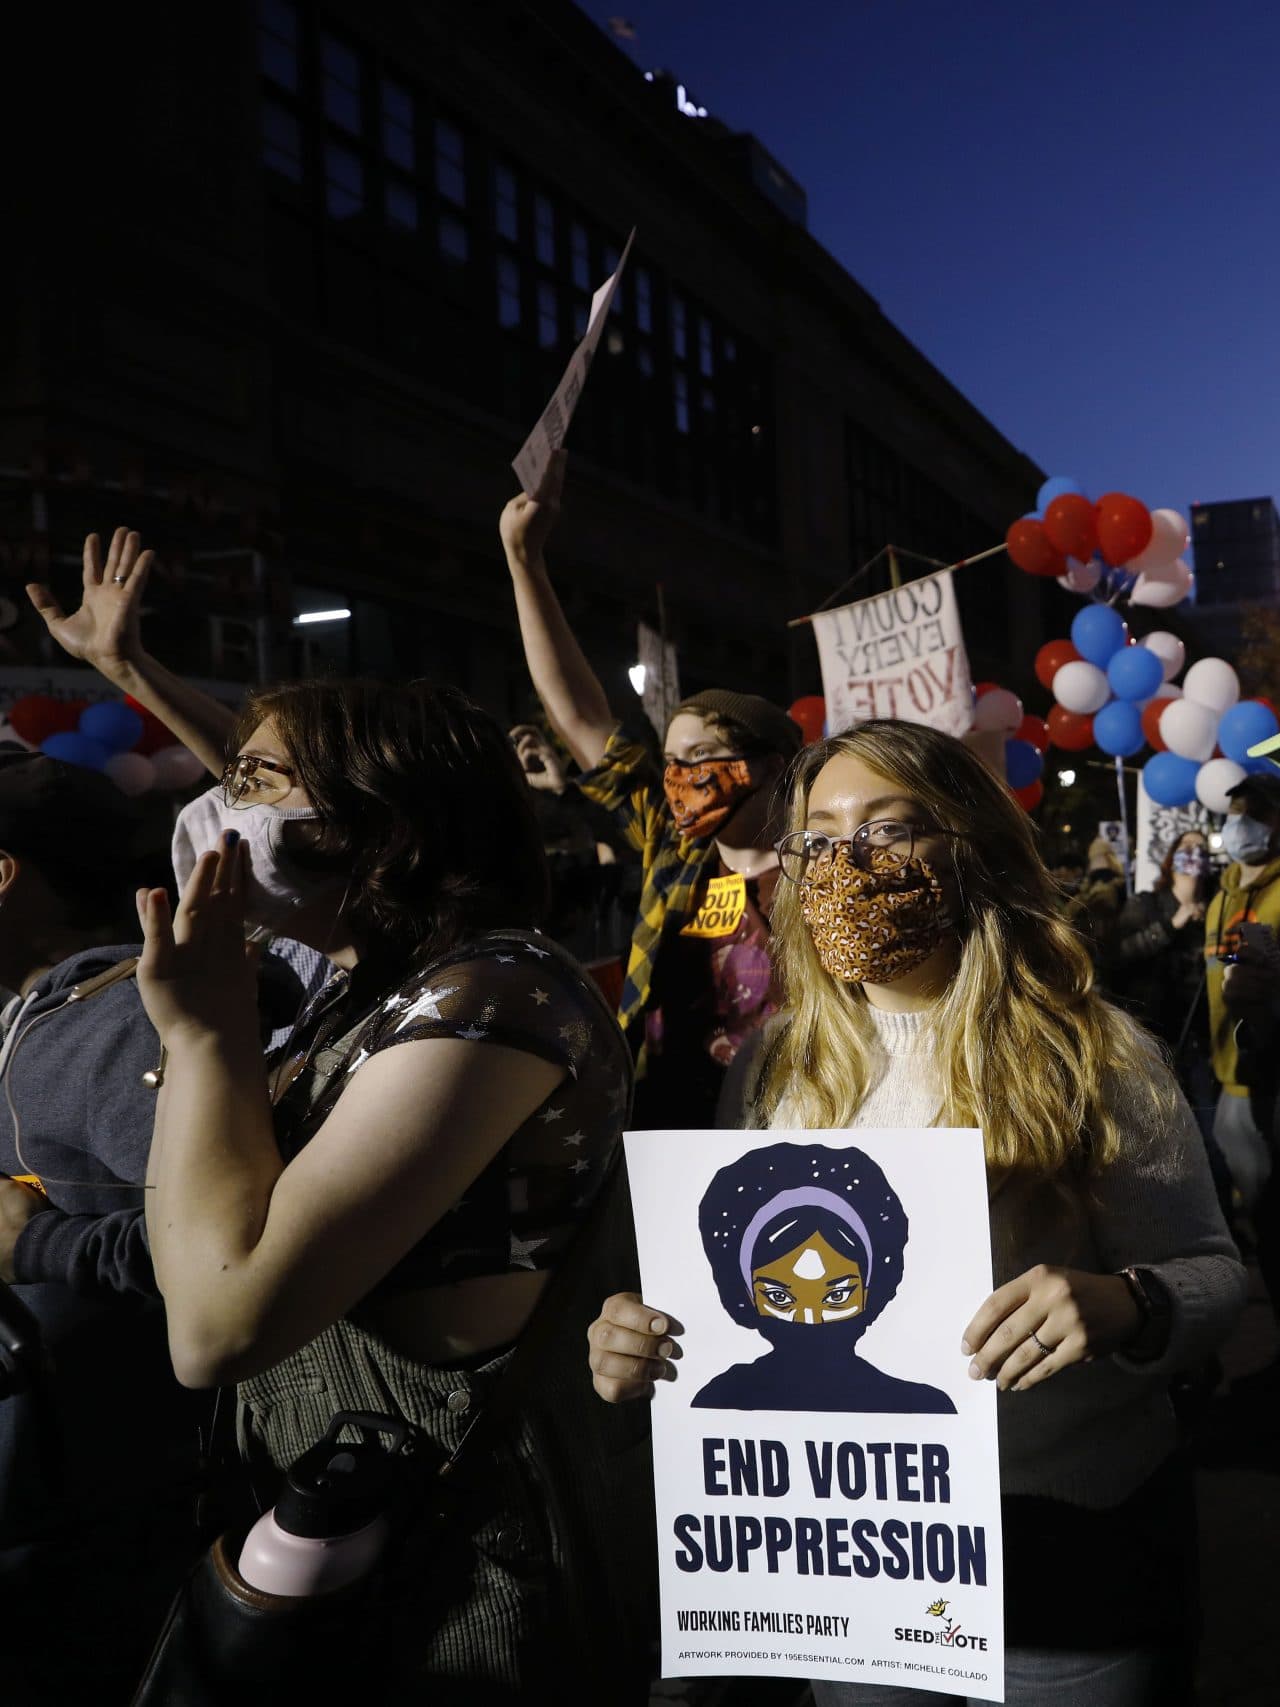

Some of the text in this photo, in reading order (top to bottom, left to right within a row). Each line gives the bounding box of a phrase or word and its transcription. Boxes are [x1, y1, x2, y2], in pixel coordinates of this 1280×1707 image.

[704, 889, 740, 910] OUT
[688, 908, 741, 929] NOW
[702, 1437, 951, 1504] END VOTER
[673, 1513, 988, 1587] SUPPRESSION
[677, 1610, 850, 1638] WORKING FAMILIES PARTY
[894, 1627, 935, 1644] SEED
[678, 1651, 722, 1659] ARTWORK
[725, 1651, 768, 1660] PROVIDED
[785, 1653, 865, 1666] 195ESSENTIAL.COM
[871, 1659, 902, 1669] ARTIST:
[904, 1662, 946, 1676] MICHELLE
[948, 1667, 988, 1681] COLLADO
